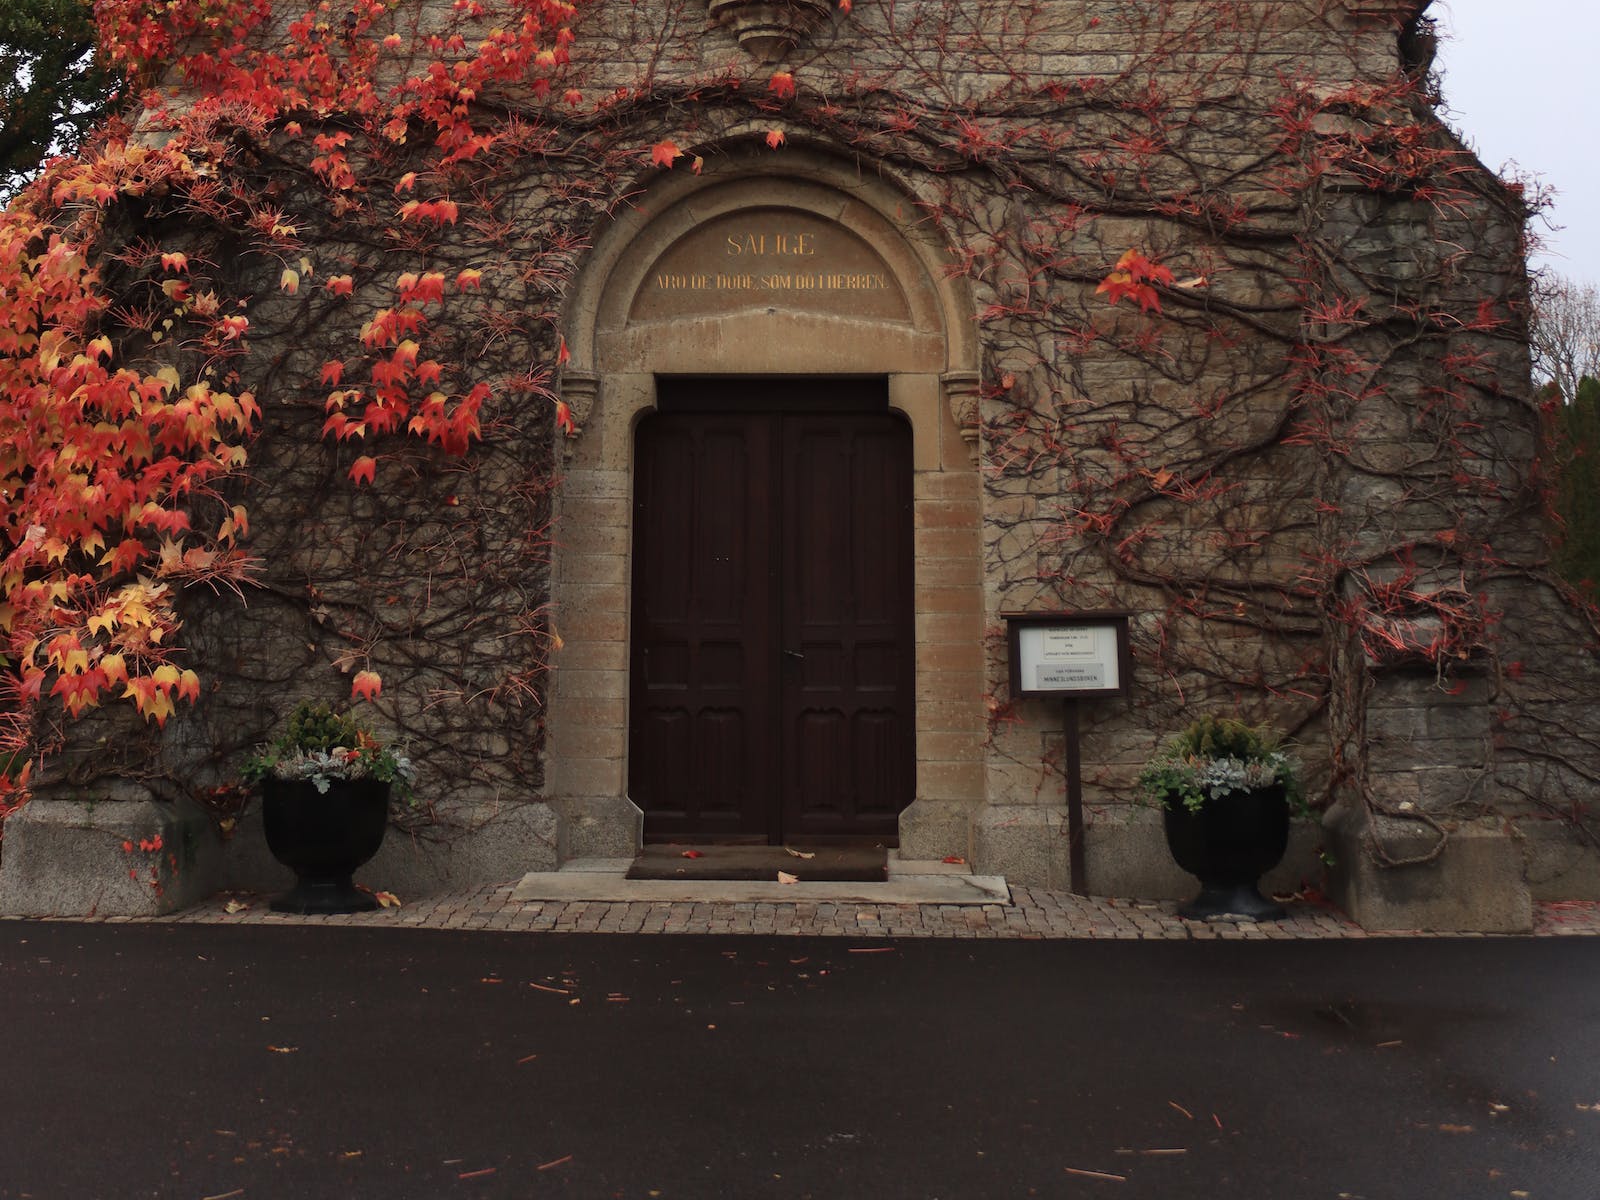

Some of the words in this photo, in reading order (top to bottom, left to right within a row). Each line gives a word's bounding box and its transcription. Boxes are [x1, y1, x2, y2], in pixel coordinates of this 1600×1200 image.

[727, 233, 816, 257] SALIGE
[690, 274, 712, 289] DE
[760, 273, 792, 289] SOM
[818, 273, 824, 289] I
